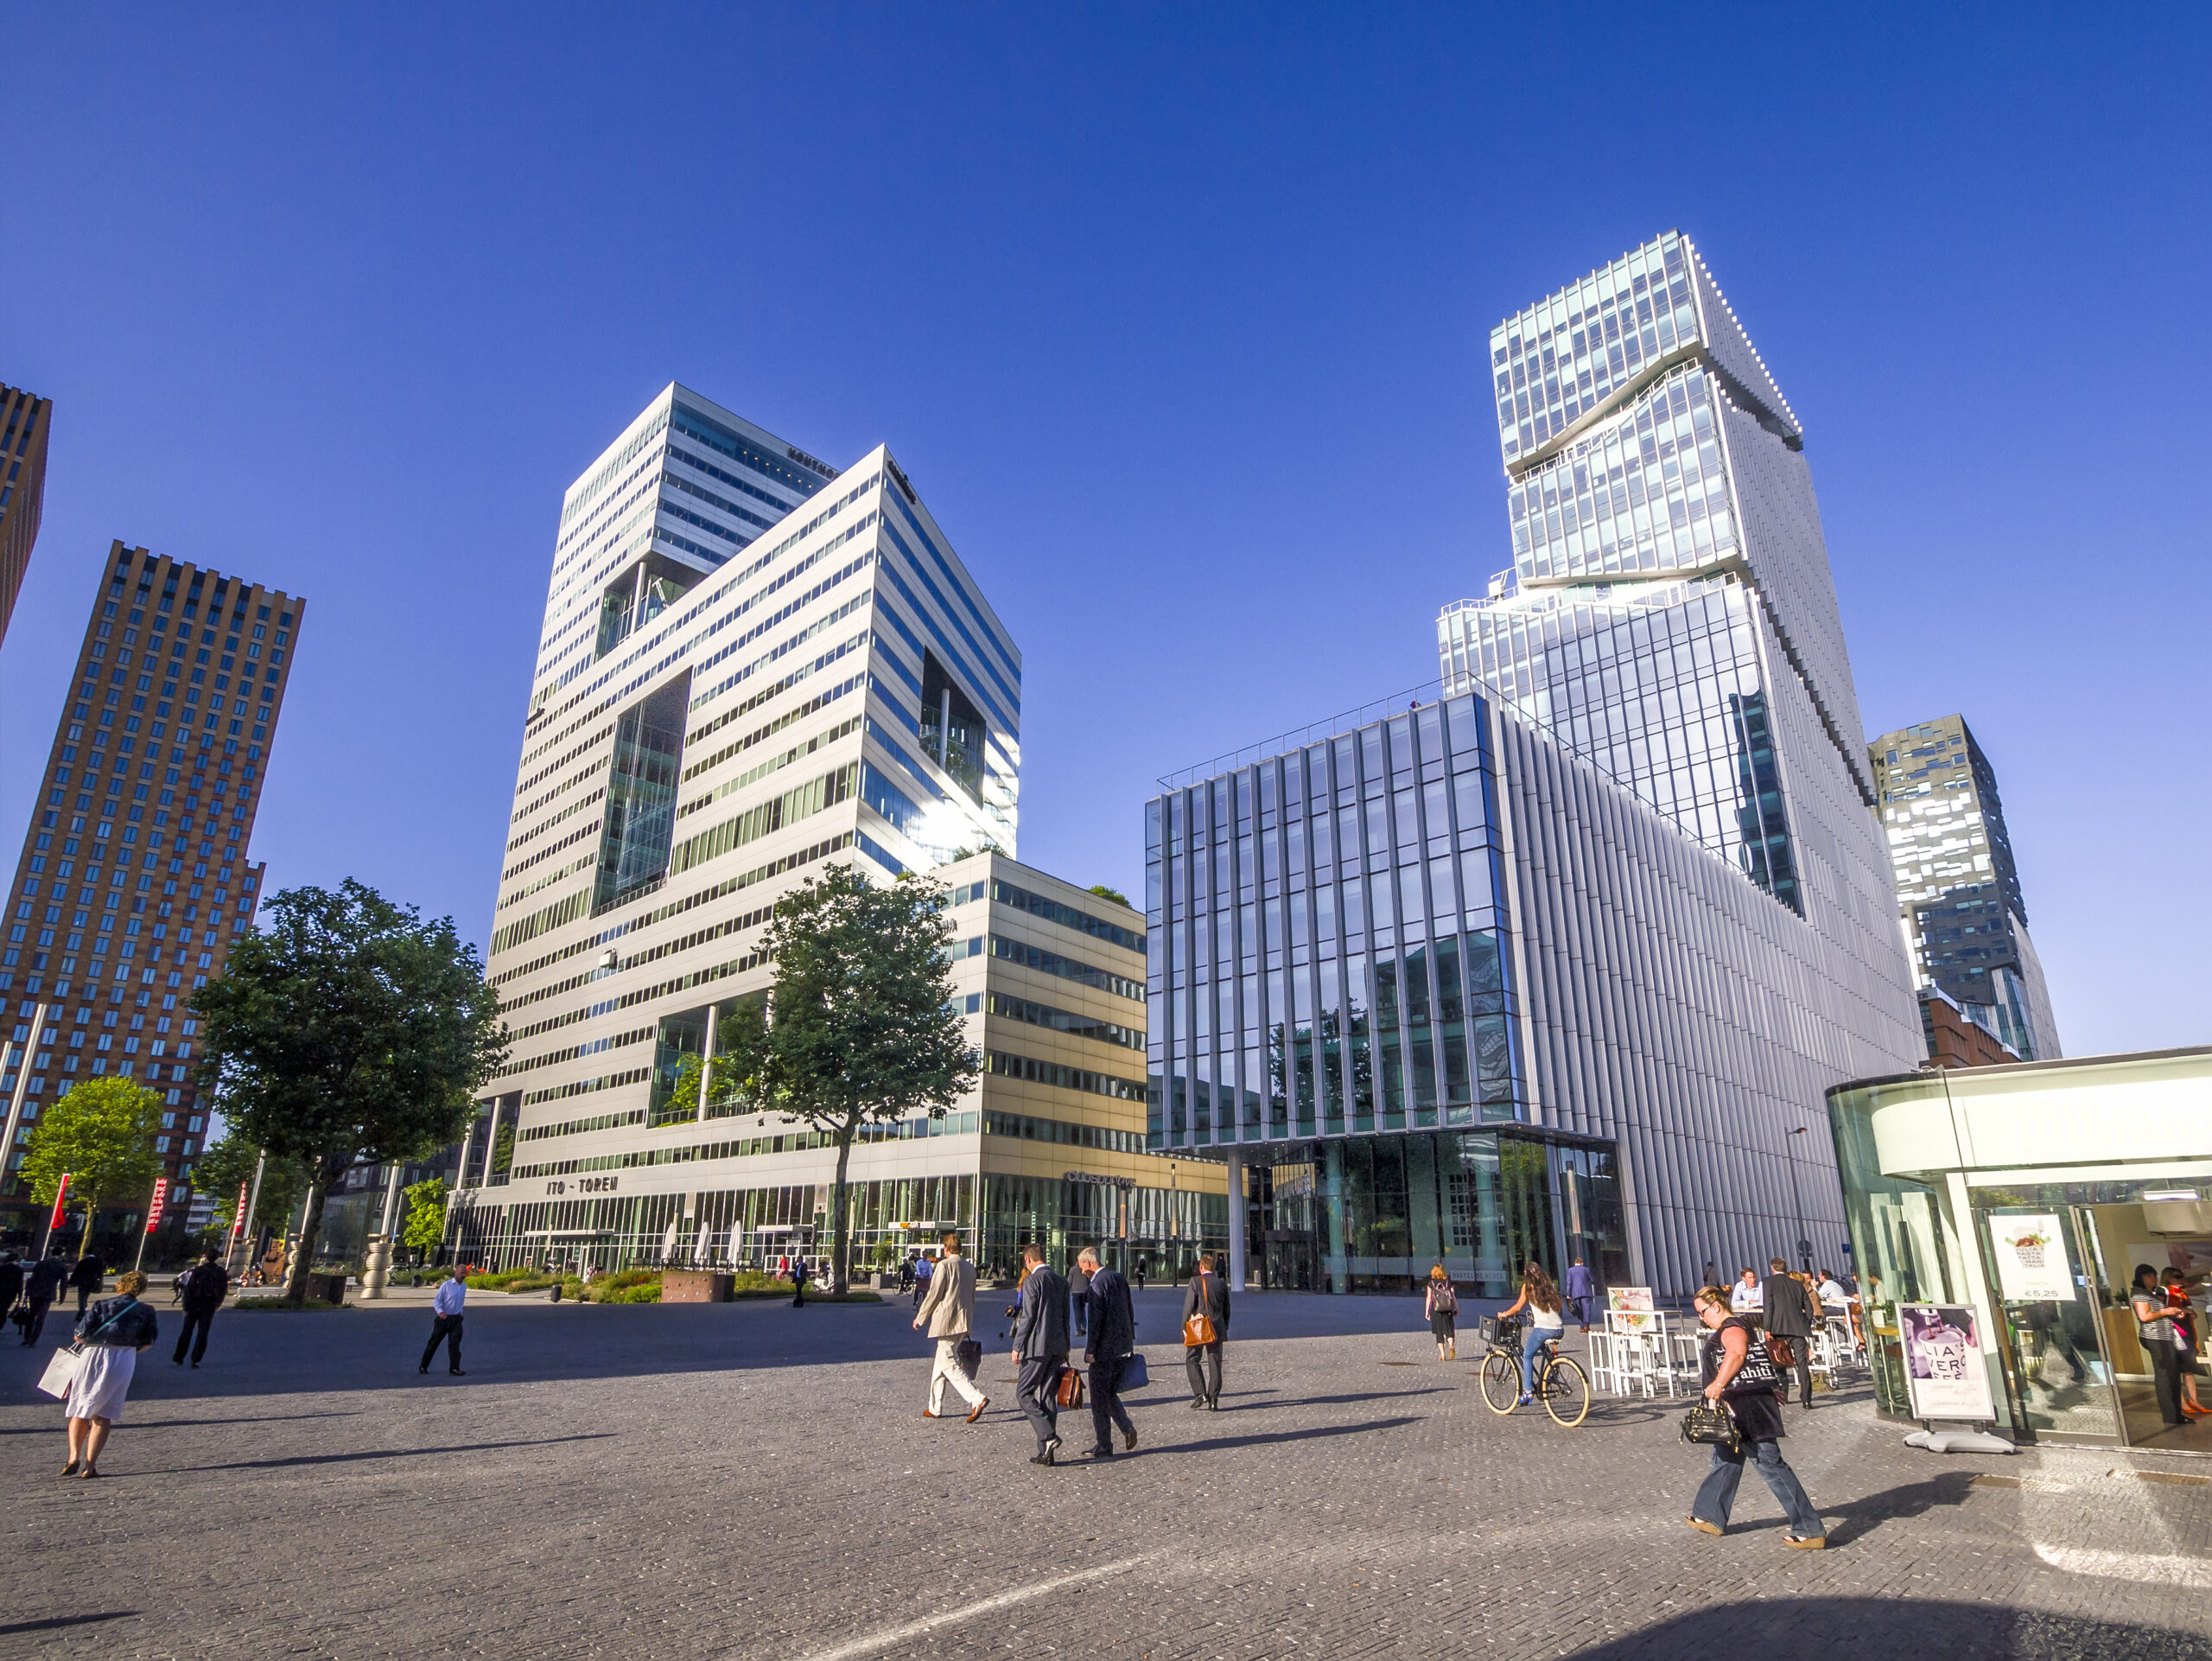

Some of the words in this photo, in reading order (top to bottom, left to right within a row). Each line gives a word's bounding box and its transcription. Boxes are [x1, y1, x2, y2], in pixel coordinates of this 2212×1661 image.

[546, 1181, 565, 1195] ITO
[579, 1176, 619, 1193] TOREN
[1739, 1366, 1772, 1379] ahiti
